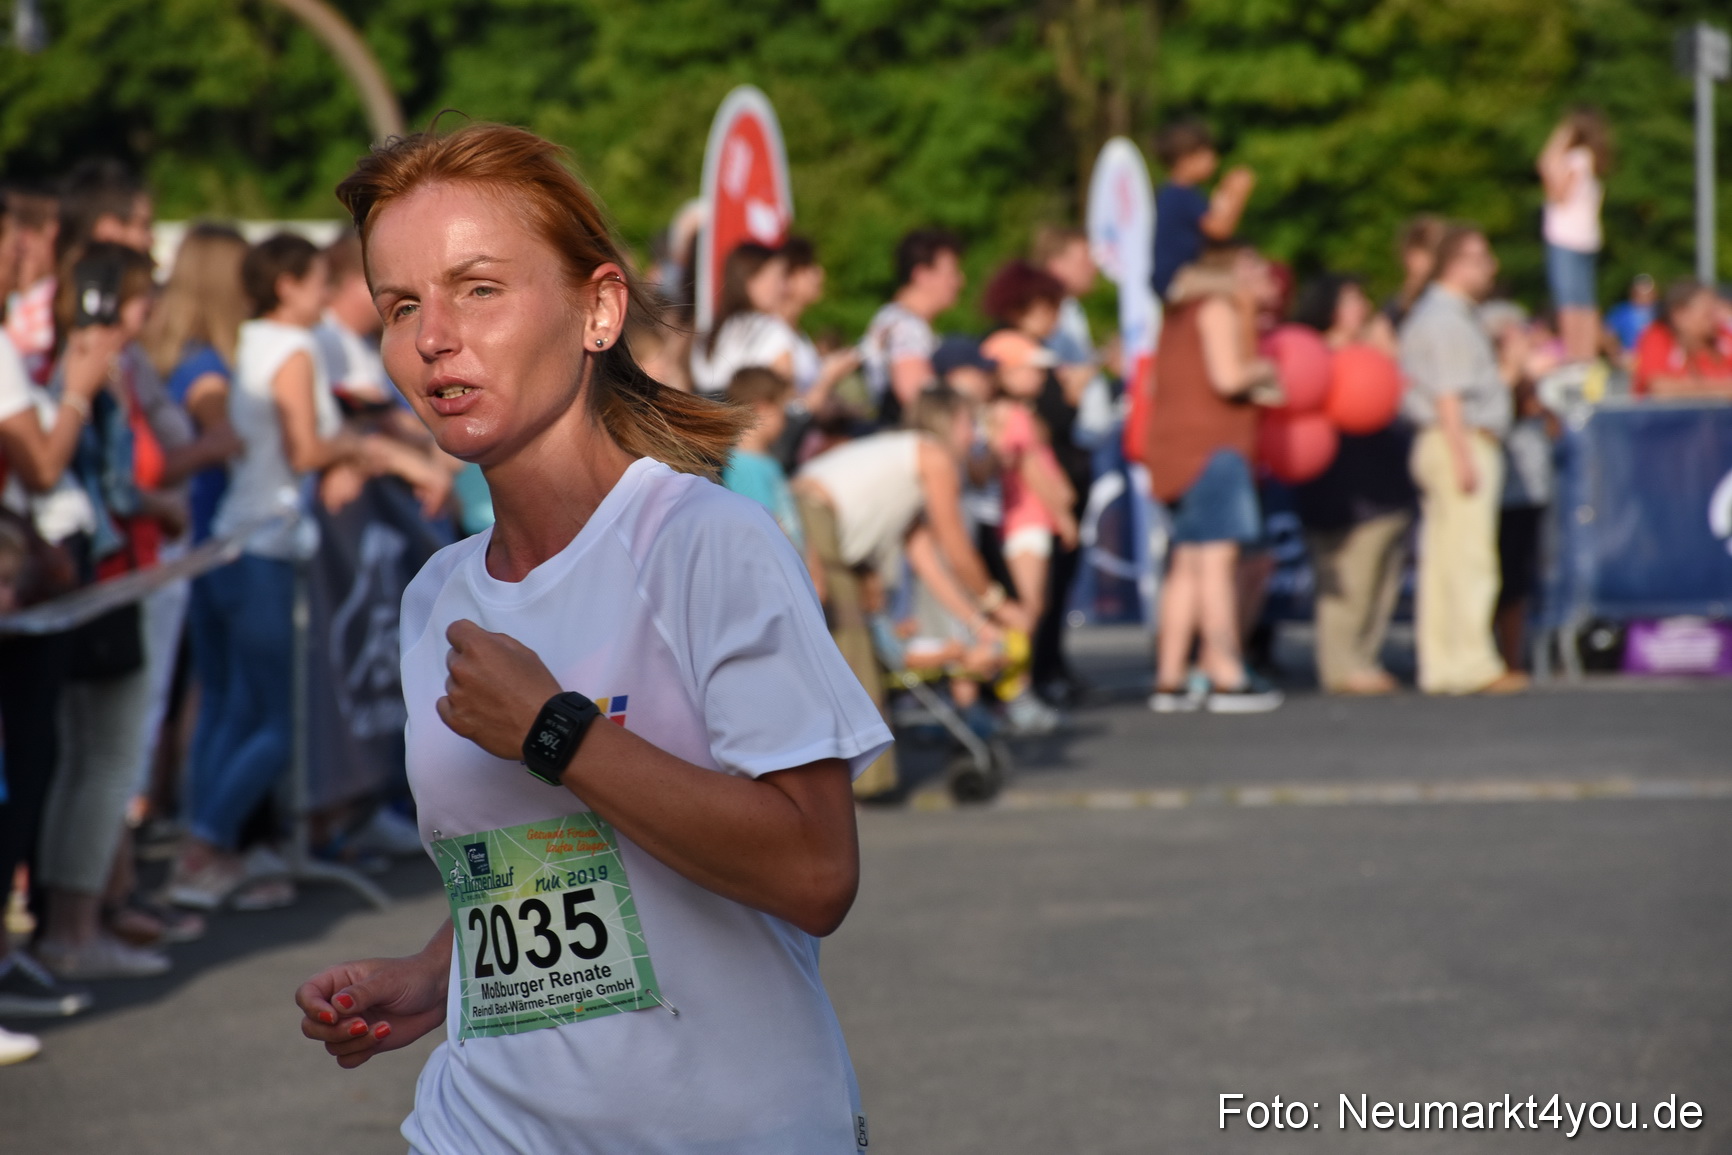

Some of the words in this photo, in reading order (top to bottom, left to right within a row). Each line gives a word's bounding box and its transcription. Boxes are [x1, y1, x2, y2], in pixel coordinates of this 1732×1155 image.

[464, 866, 514, 892] firmenlauf
[535, 875, 561, 892] run
[567, 865, 608, 887] 2019
[468, 888, 608, 979] 2035
[472, 1002, 494, 1018] Reindl
[495, 987, 593, 1014] Bad-Wärme-Energie
[596, 978, 635, 996] GmbH
[481, 976, 545, 1000] Moßburger
[549, 964, 612, 989] Renate
